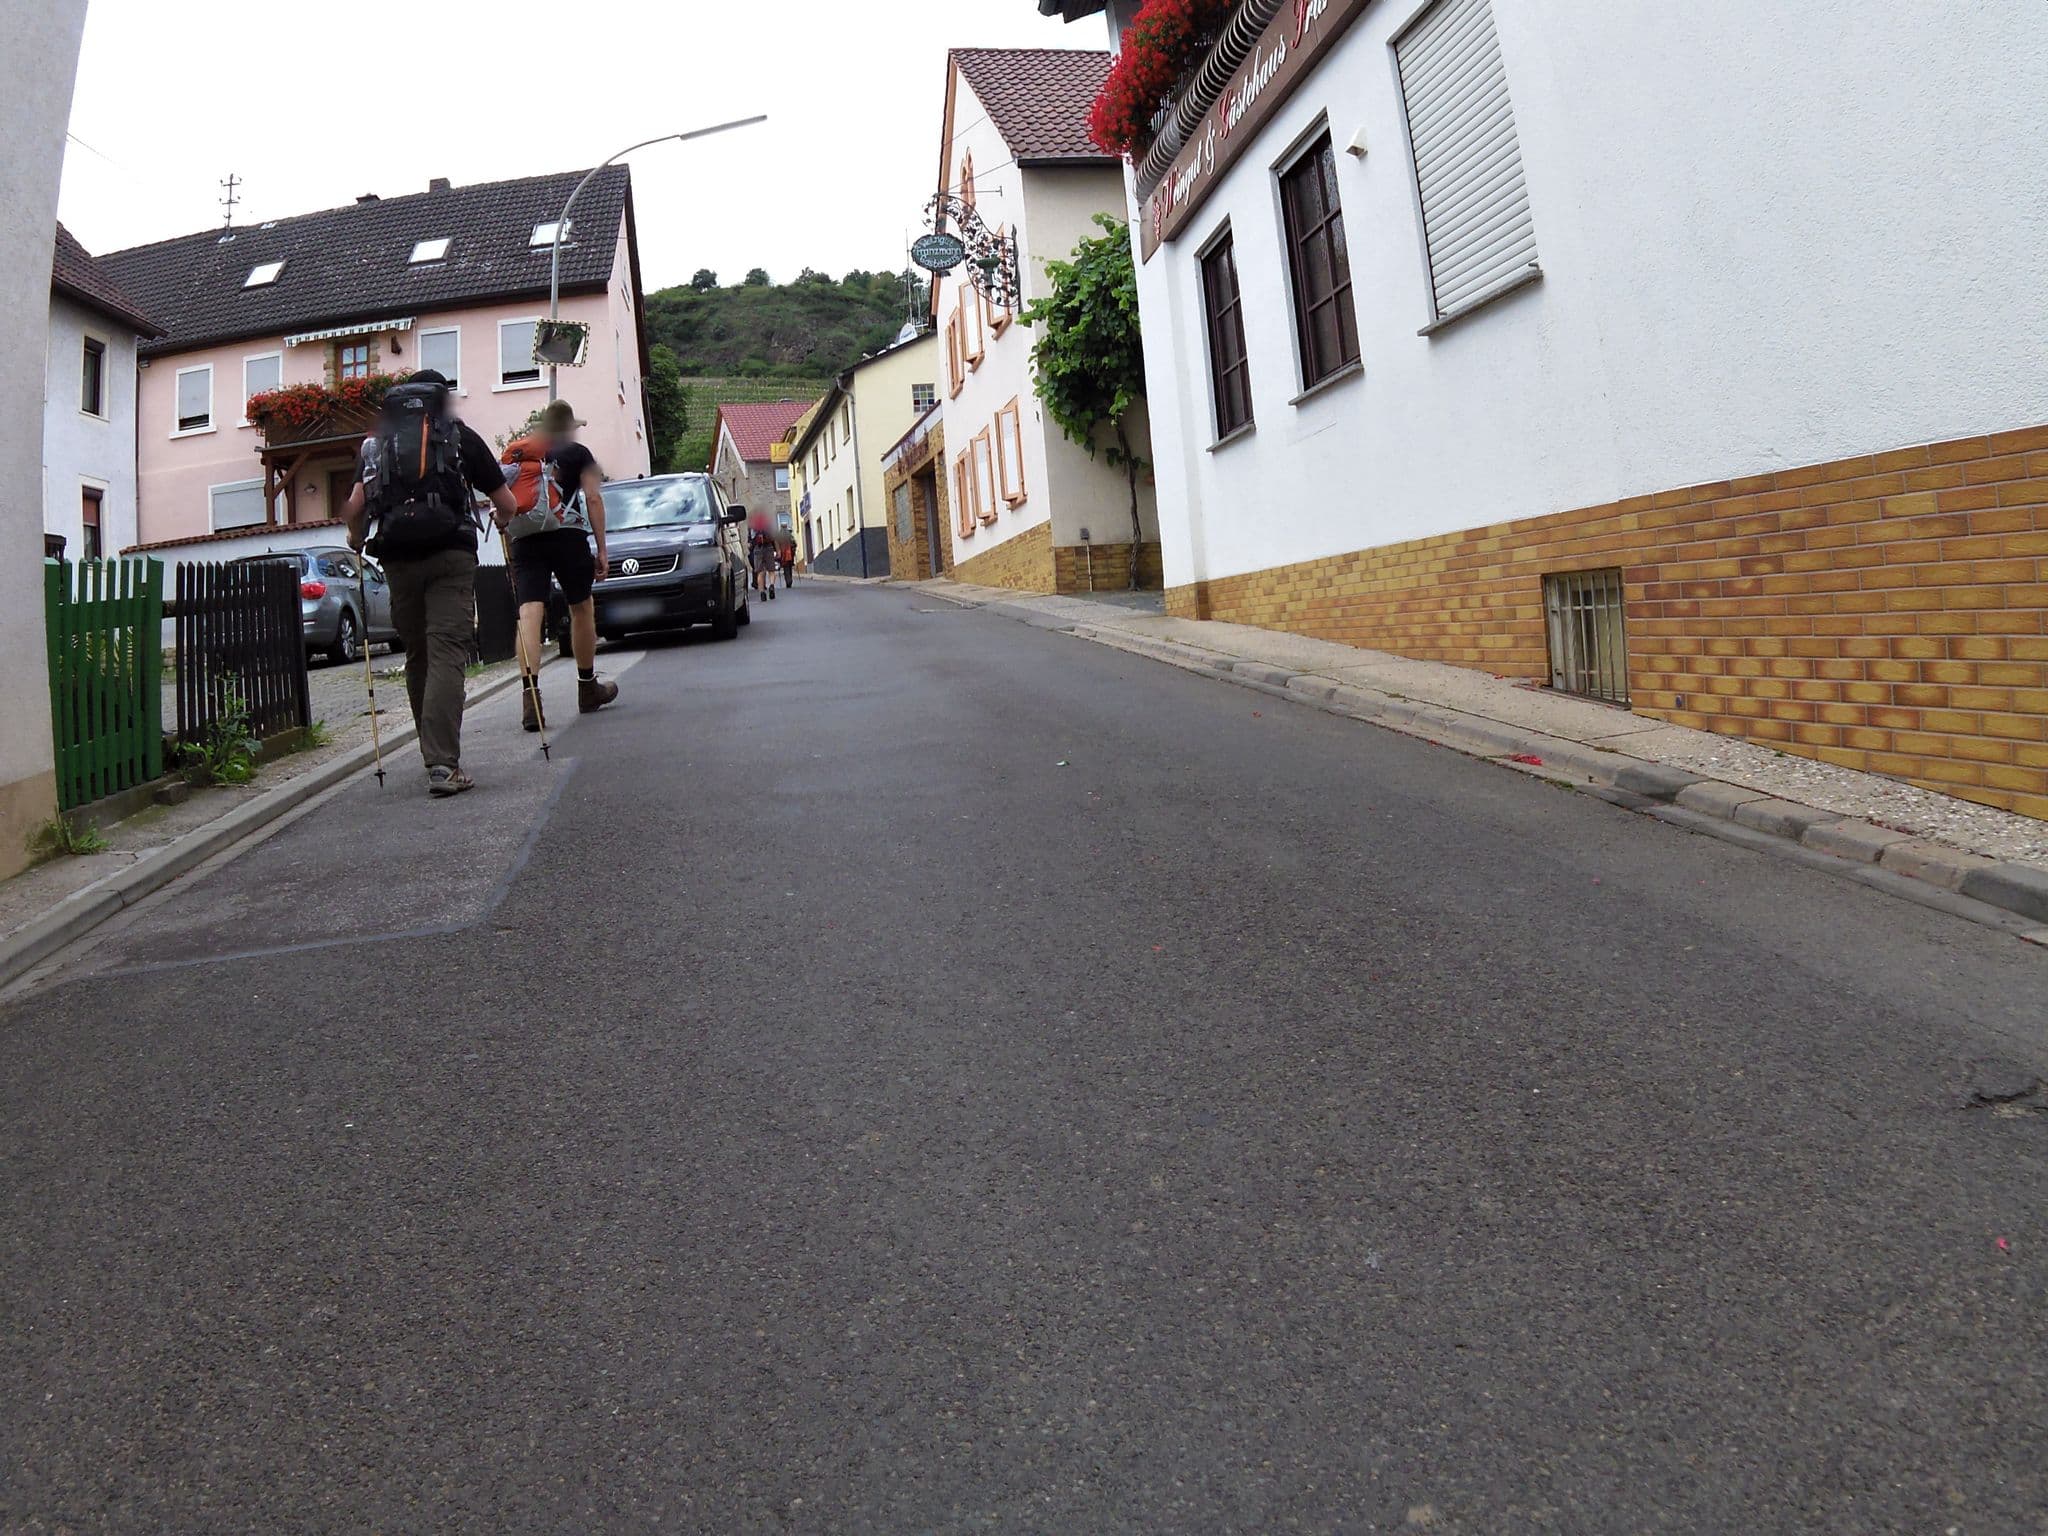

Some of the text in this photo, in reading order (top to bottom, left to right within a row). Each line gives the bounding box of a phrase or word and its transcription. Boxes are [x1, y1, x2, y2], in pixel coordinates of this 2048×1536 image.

[1162, 141, 1202, 219] Weingut
[1205, 120, 1216, 176] &
[1218, 34, 1287, 140] Gästehaus
